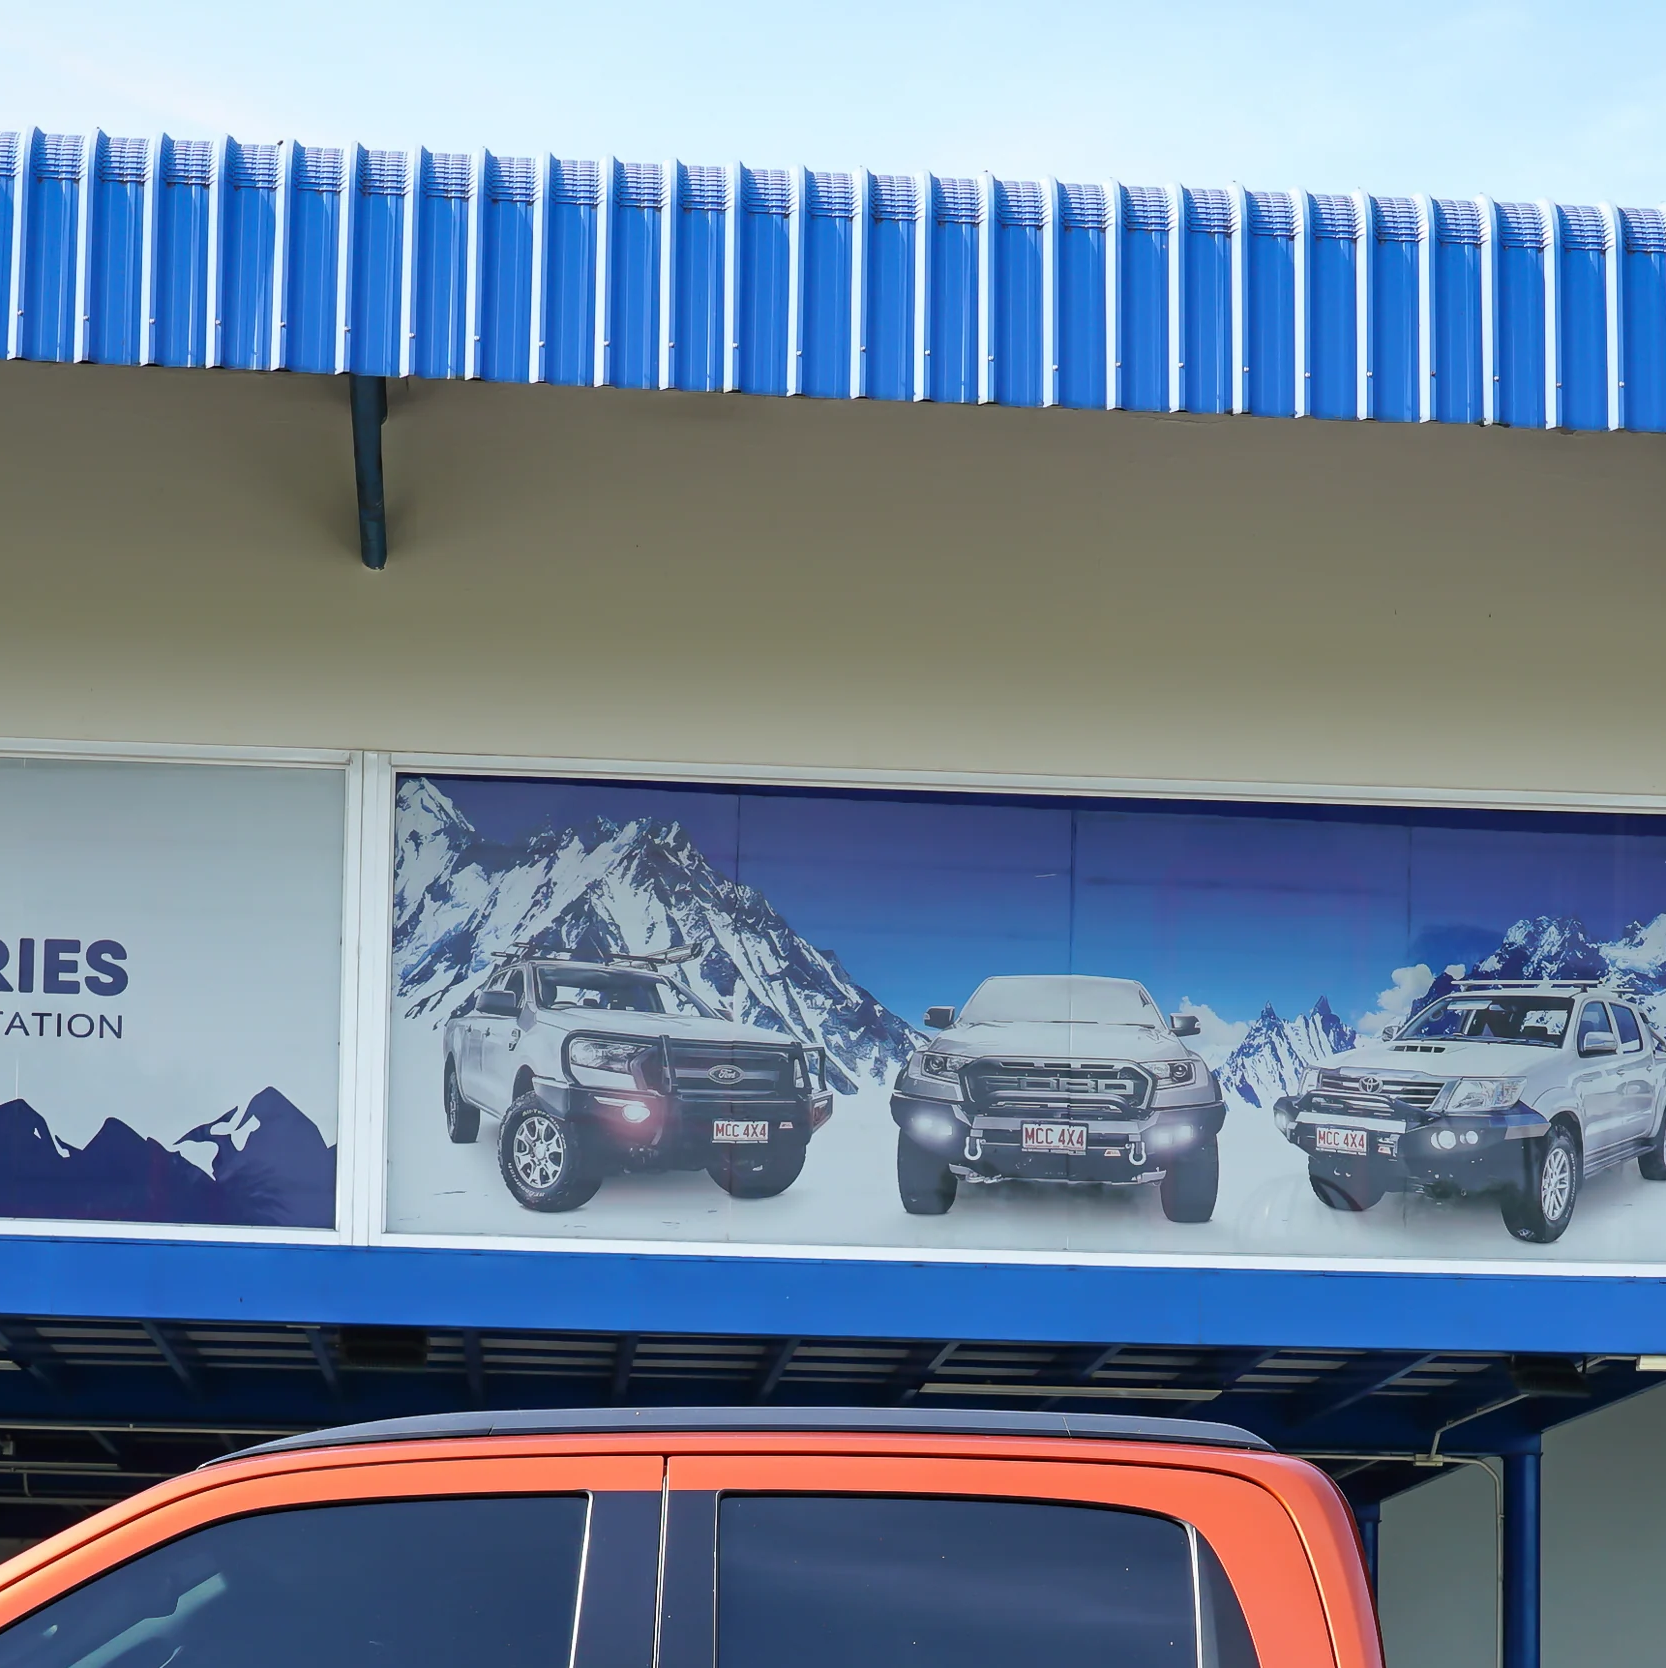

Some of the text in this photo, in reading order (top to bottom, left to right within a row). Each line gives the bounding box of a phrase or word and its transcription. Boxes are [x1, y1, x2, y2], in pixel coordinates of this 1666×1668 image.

[715, 1121, 768, 1139] MCC 4X4
[1024, 1125, 1086, 1147] MCC 4X4
[1318, 1129, 1366, 1149] MCC 4X4
